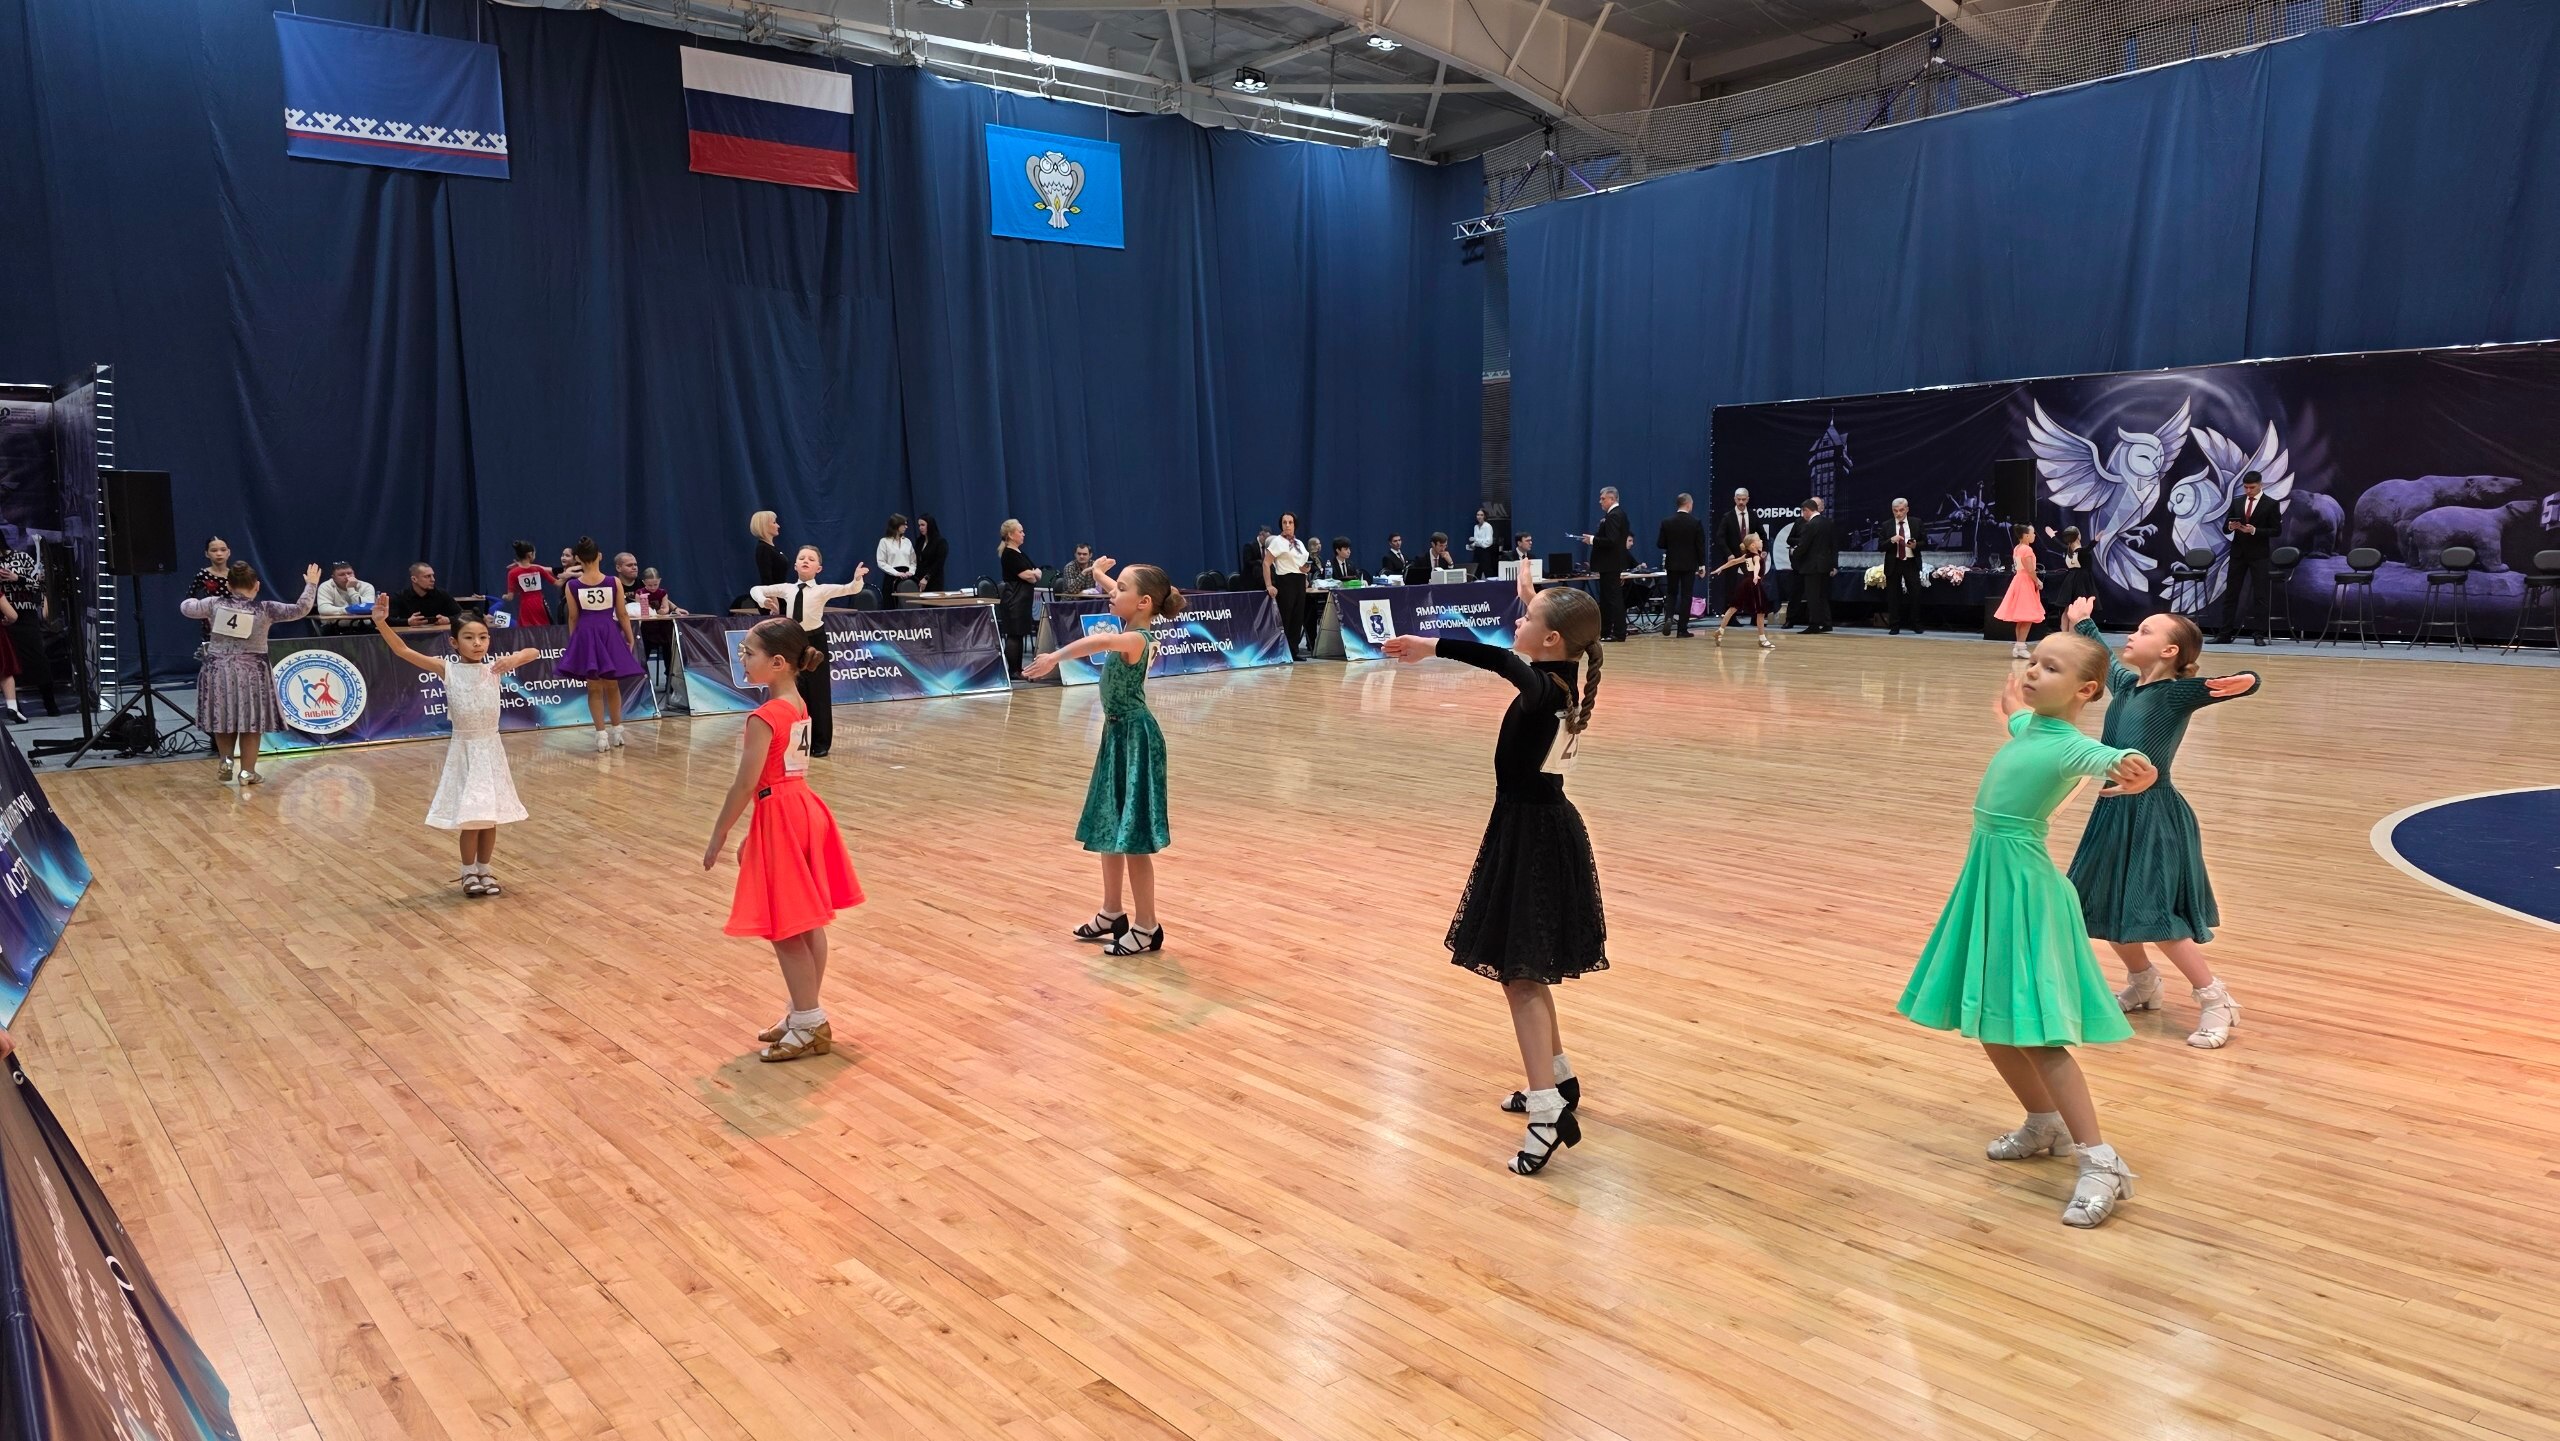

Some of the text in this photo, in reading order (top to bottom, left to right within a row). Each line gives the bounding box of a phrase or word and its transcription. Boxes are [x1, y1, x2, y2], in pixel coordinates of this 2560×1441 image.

[1753, 507, 1804, 518] ОЯБРЬС
[523, 576, 538, 588] 94
[587, 589, 605, 604] 53
[1416, 601, 1491, 617] ЯМАЛО-НЕНЕЦКИЙ
[226, 613, 238, 630] 4
[1419, 616, 1501, 631] АВТОНОМНЫЙ ОКРУГ
[825, 627, 933, 645] ДМИНИСТРАЦИЯ
[1190, 638, 1234, 653] УРЕНГОЙ
[828, 648, 874, 663] ОРОДА
[829, 665, 903, 681] ОЯБРЬСКА
[526, 694, 562, 707] ЯНАО
